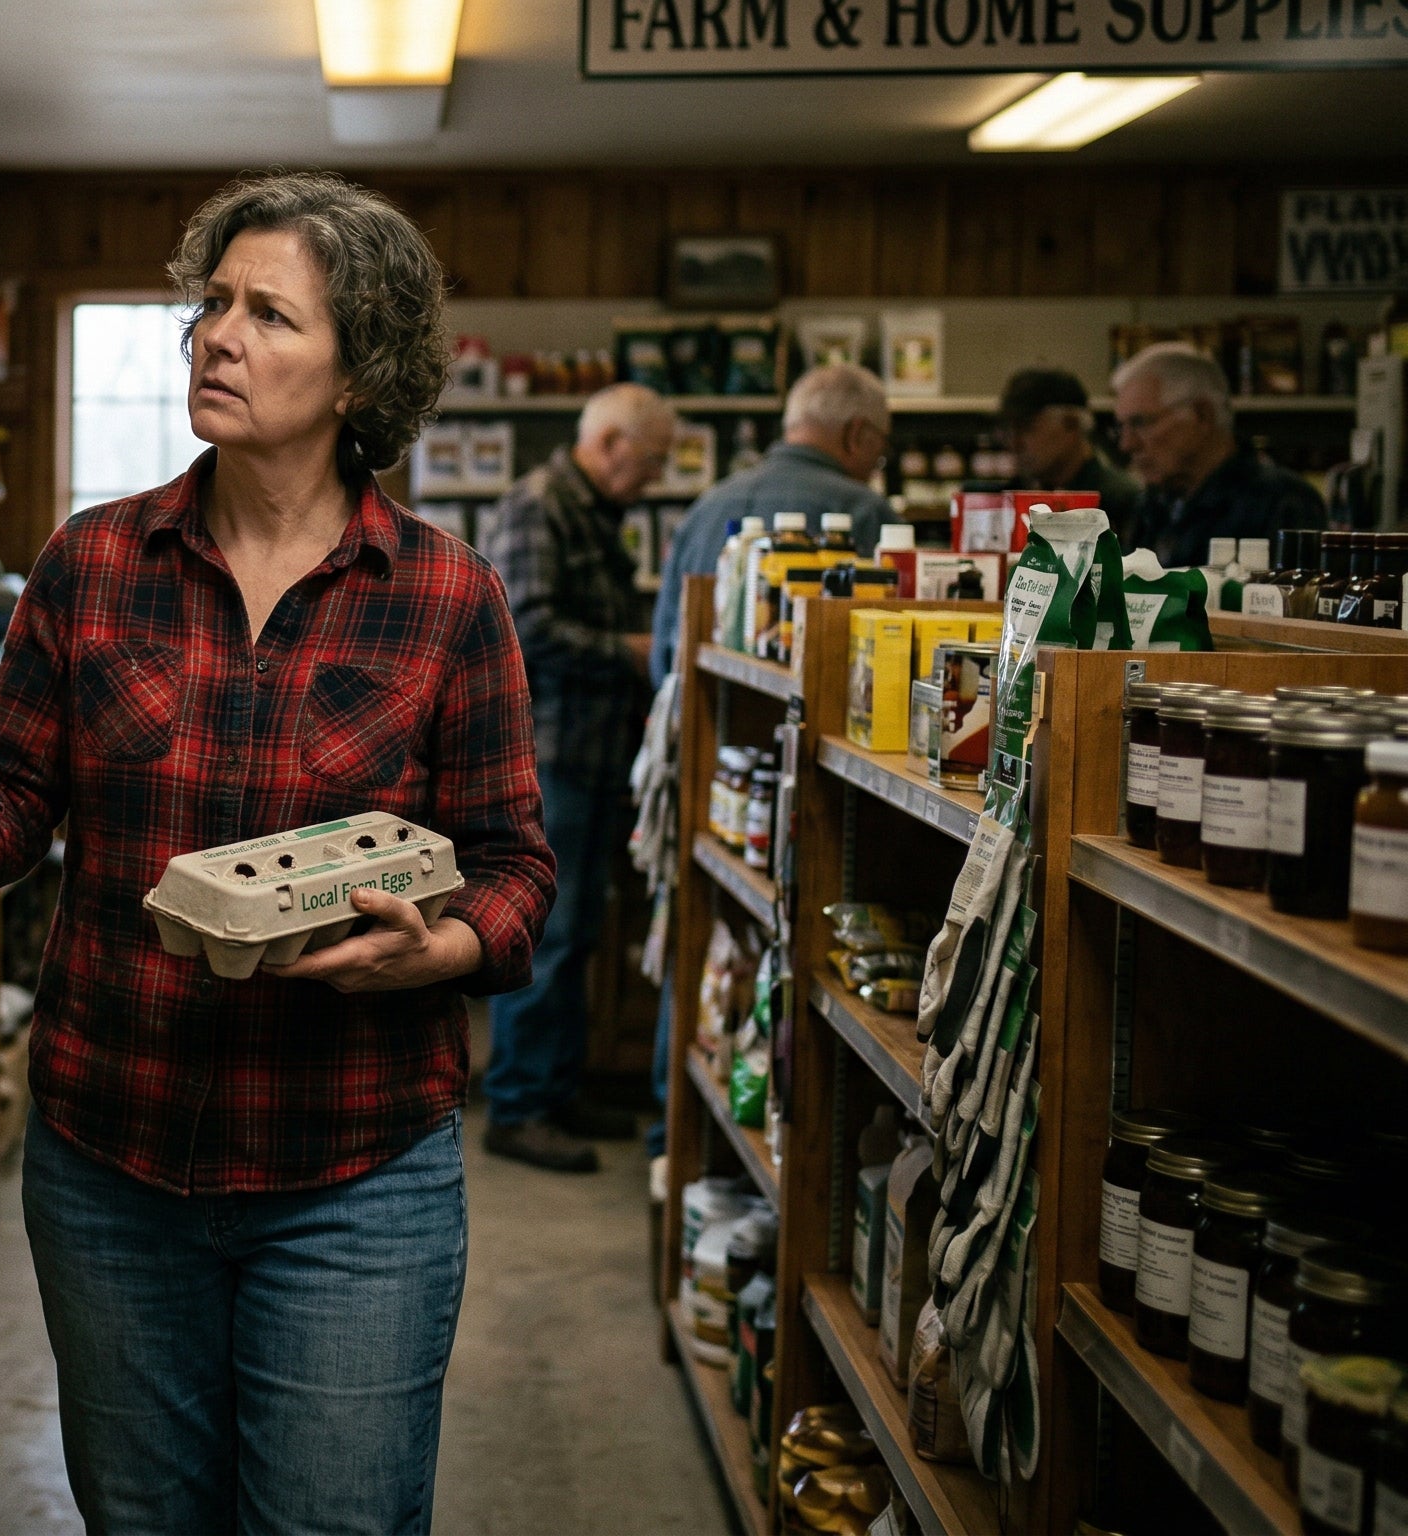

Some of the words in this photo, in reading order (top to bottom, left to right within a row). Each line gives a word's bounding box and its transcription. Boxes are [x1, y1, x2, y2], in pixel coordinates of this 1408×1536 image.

[610, 0, 789, 51] FARM
[813, 0, 862, 49] &
[884, 0, 1082, 47] HOME
[1105, 0, 1408, 45] SUPPLIE
[301, 884, 338, 912] Local
[381, 871, 413, 894] Eggs
